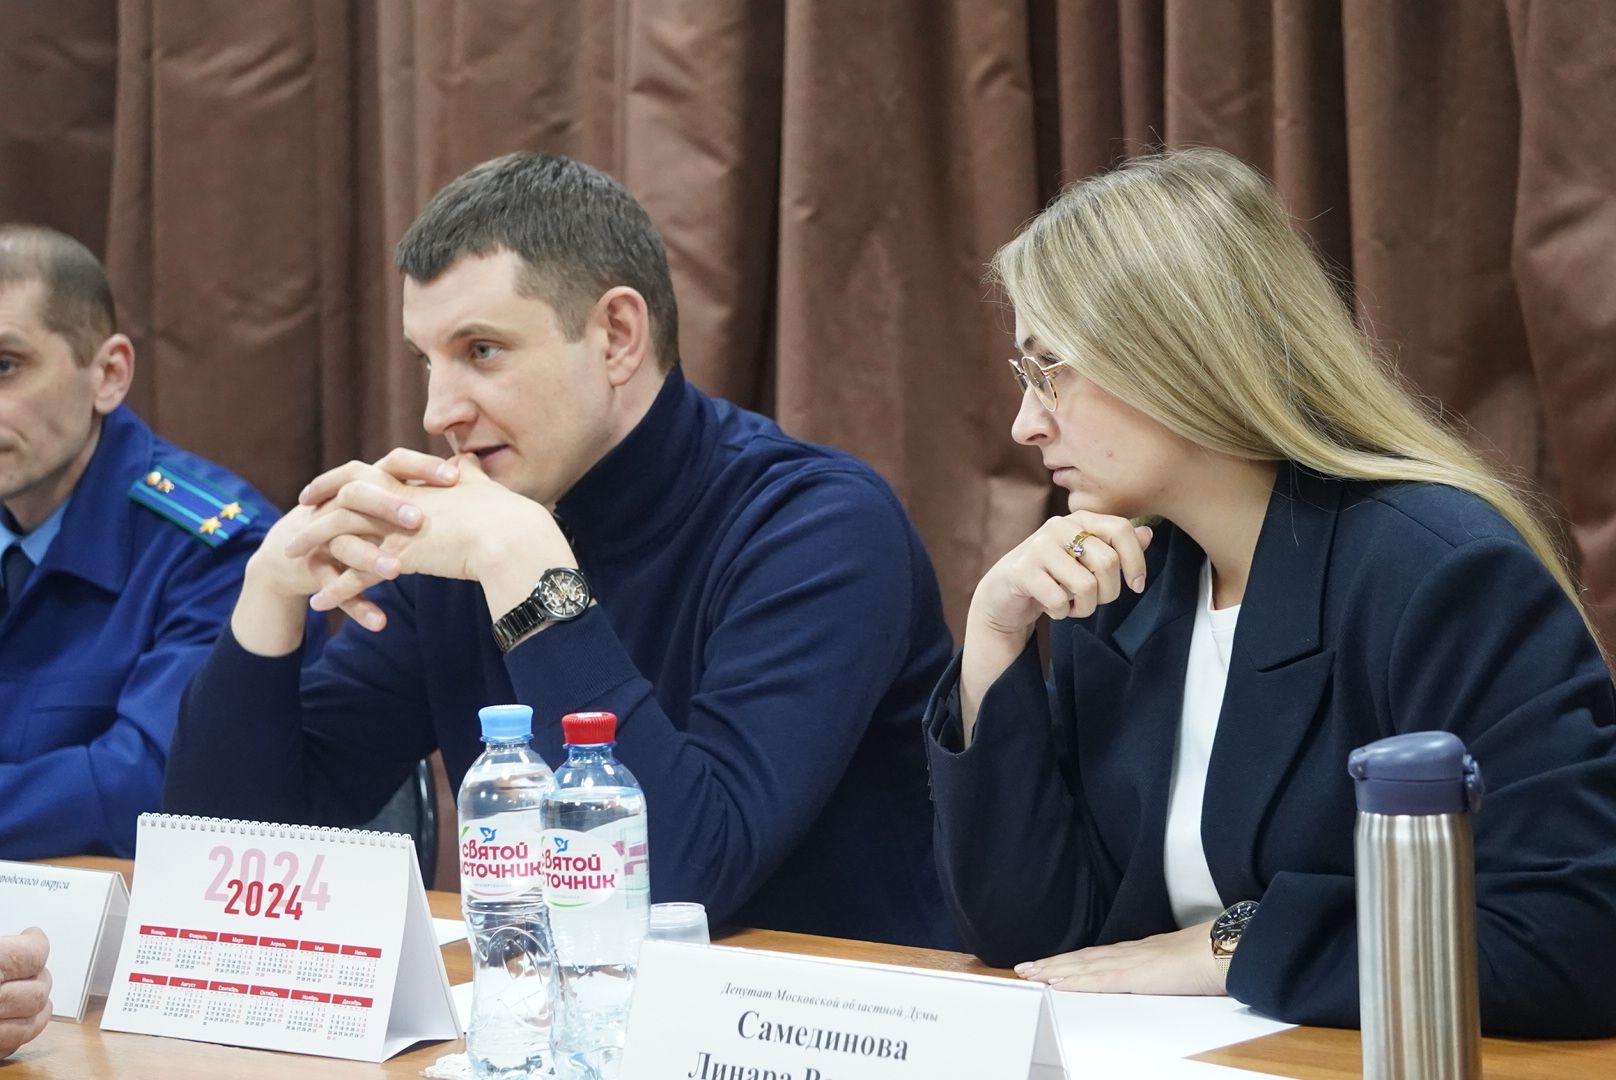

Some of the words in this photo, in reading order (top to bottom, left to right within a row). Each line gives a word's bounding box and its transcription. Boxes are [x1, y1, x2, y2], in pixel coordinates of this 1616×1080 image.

[204, 845, 331, 911] 2024
[224, 879, 303, 920] 2024
[720, 981, 772, 999] Депутат
[774, 988, 840, 1009] Московской
[842, 999, 904, 1018] областной
[905, 1006, 939, 1023] Думы
[737, 1009, 908, 1061] Самединова
